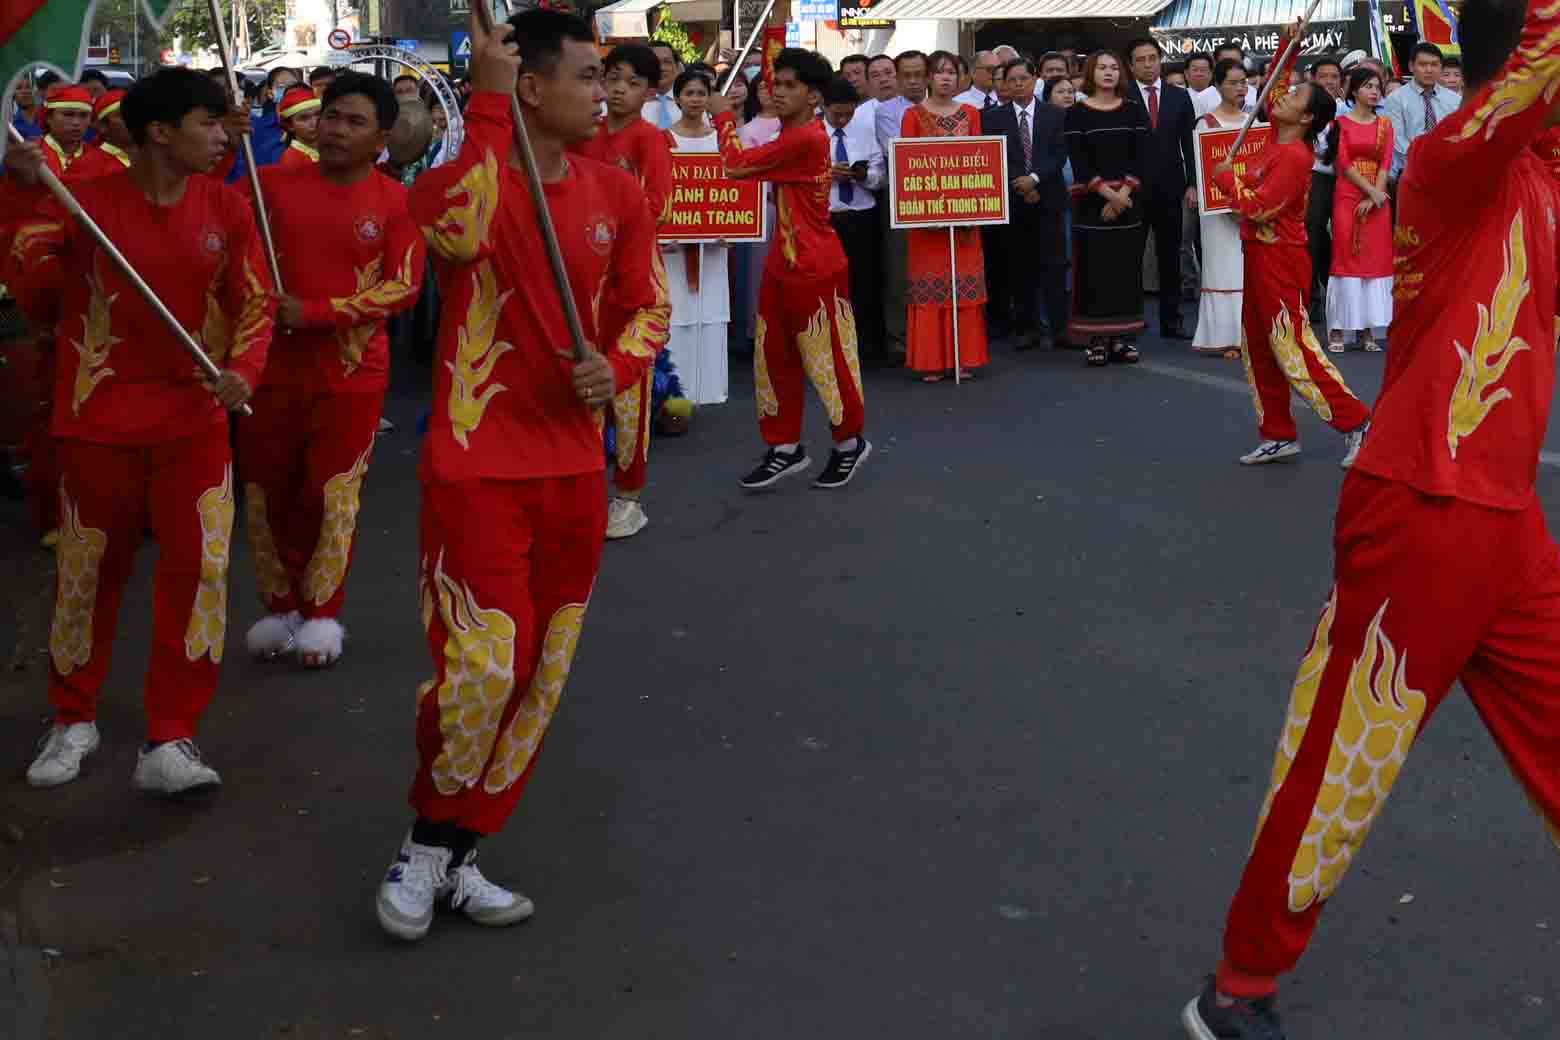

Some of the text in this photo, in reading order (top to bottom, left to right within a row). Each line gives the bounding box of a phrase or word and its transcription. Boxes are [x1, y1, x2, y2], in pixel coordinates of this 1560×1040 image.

[1255, 30, 1280, 51] PHÊ
[1312, 28, 1344, 48] MÁY
[672, 209, 754, 225] NHA TRANG
